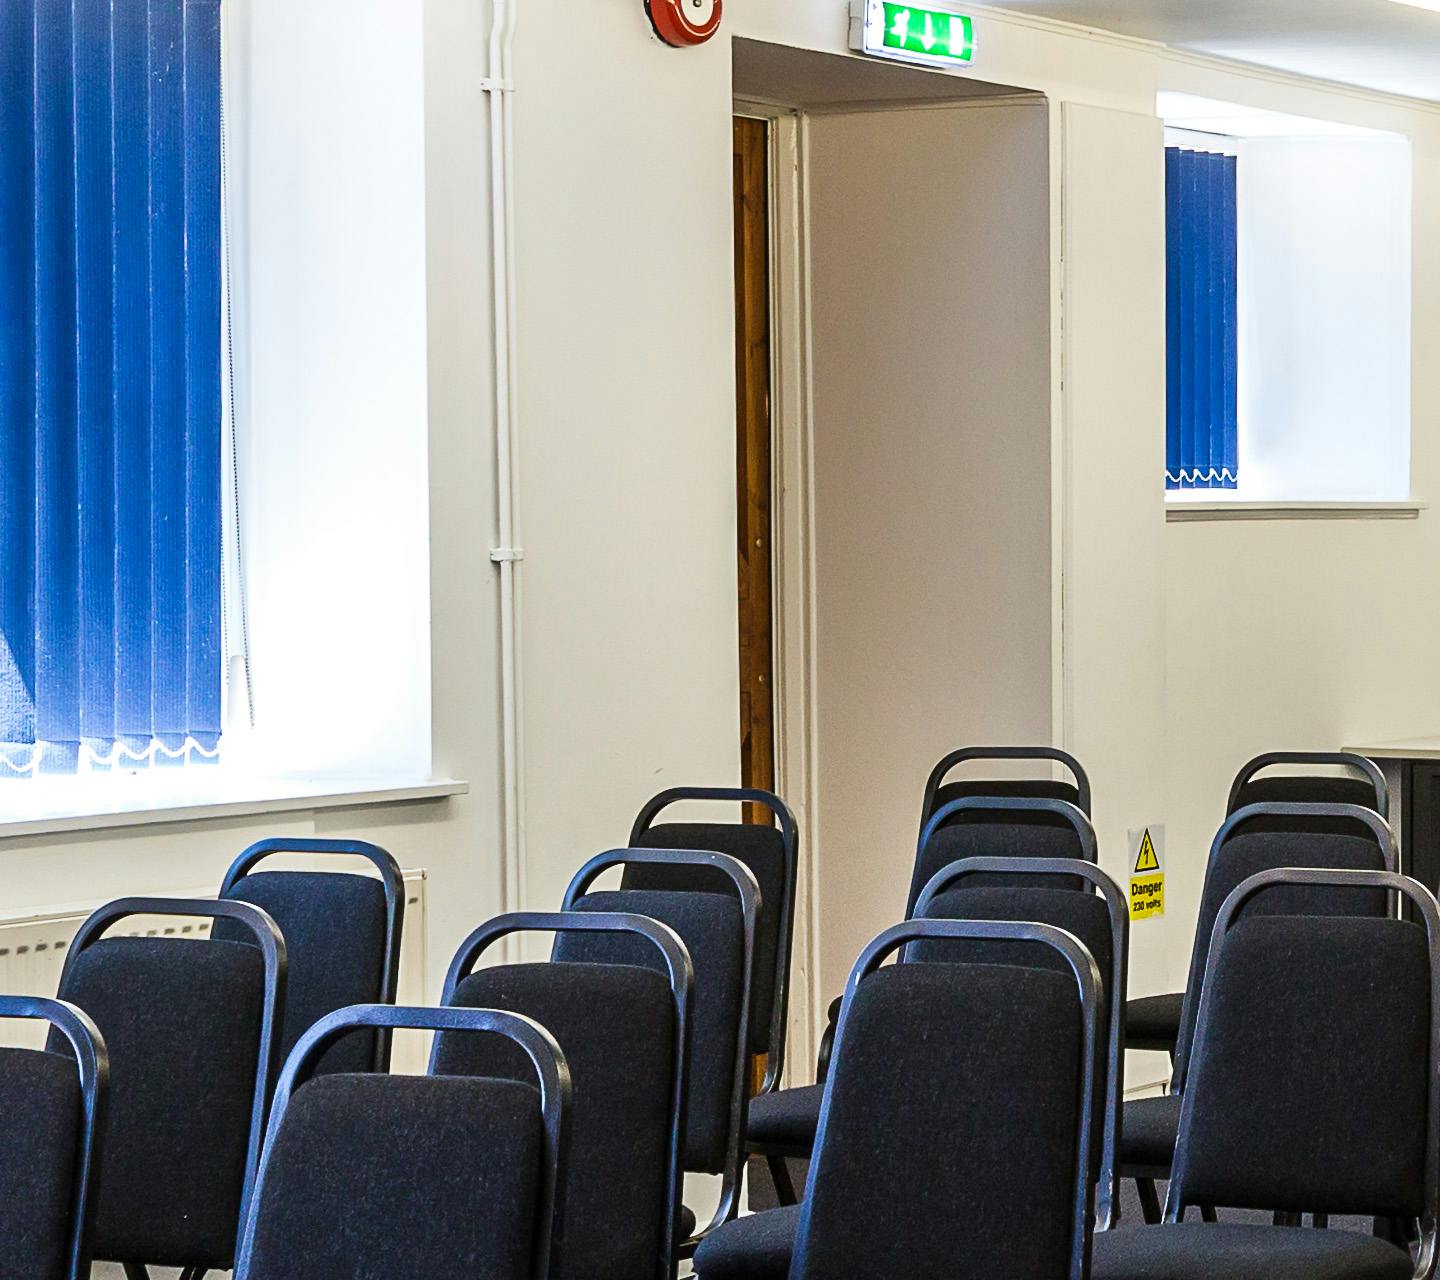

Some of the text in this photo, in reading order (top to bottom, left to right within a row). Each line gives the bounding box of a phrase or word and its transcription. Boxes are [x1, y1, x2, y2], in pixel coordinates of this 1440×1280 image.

[1131, 882, 1162, 896] Danger
[1133, 899, 1161, 911] 230 volts
